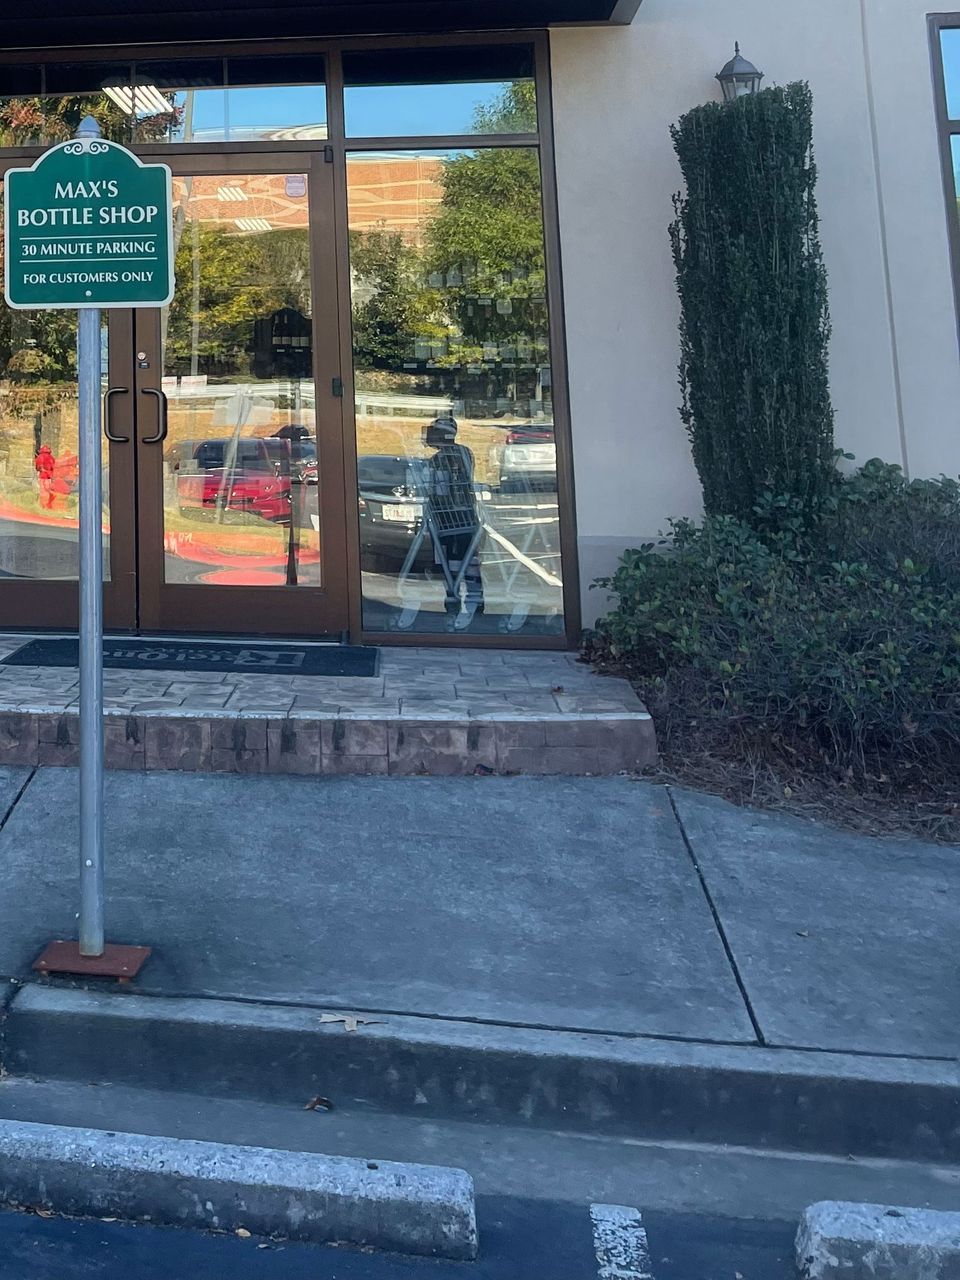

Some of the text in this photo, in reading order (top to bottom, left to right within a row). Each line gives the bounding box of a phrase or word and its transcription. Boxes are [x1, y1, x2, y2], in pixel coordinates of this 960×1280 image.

[55, 180, 119, 199] MAX'S
[18, 205, 158, 227] BOTTLE SHOP
[22, 241, 156, 256] 30 MINUTE PARKING
[23, 271, 154, 284] FOR CUSTOMERS ONLY
